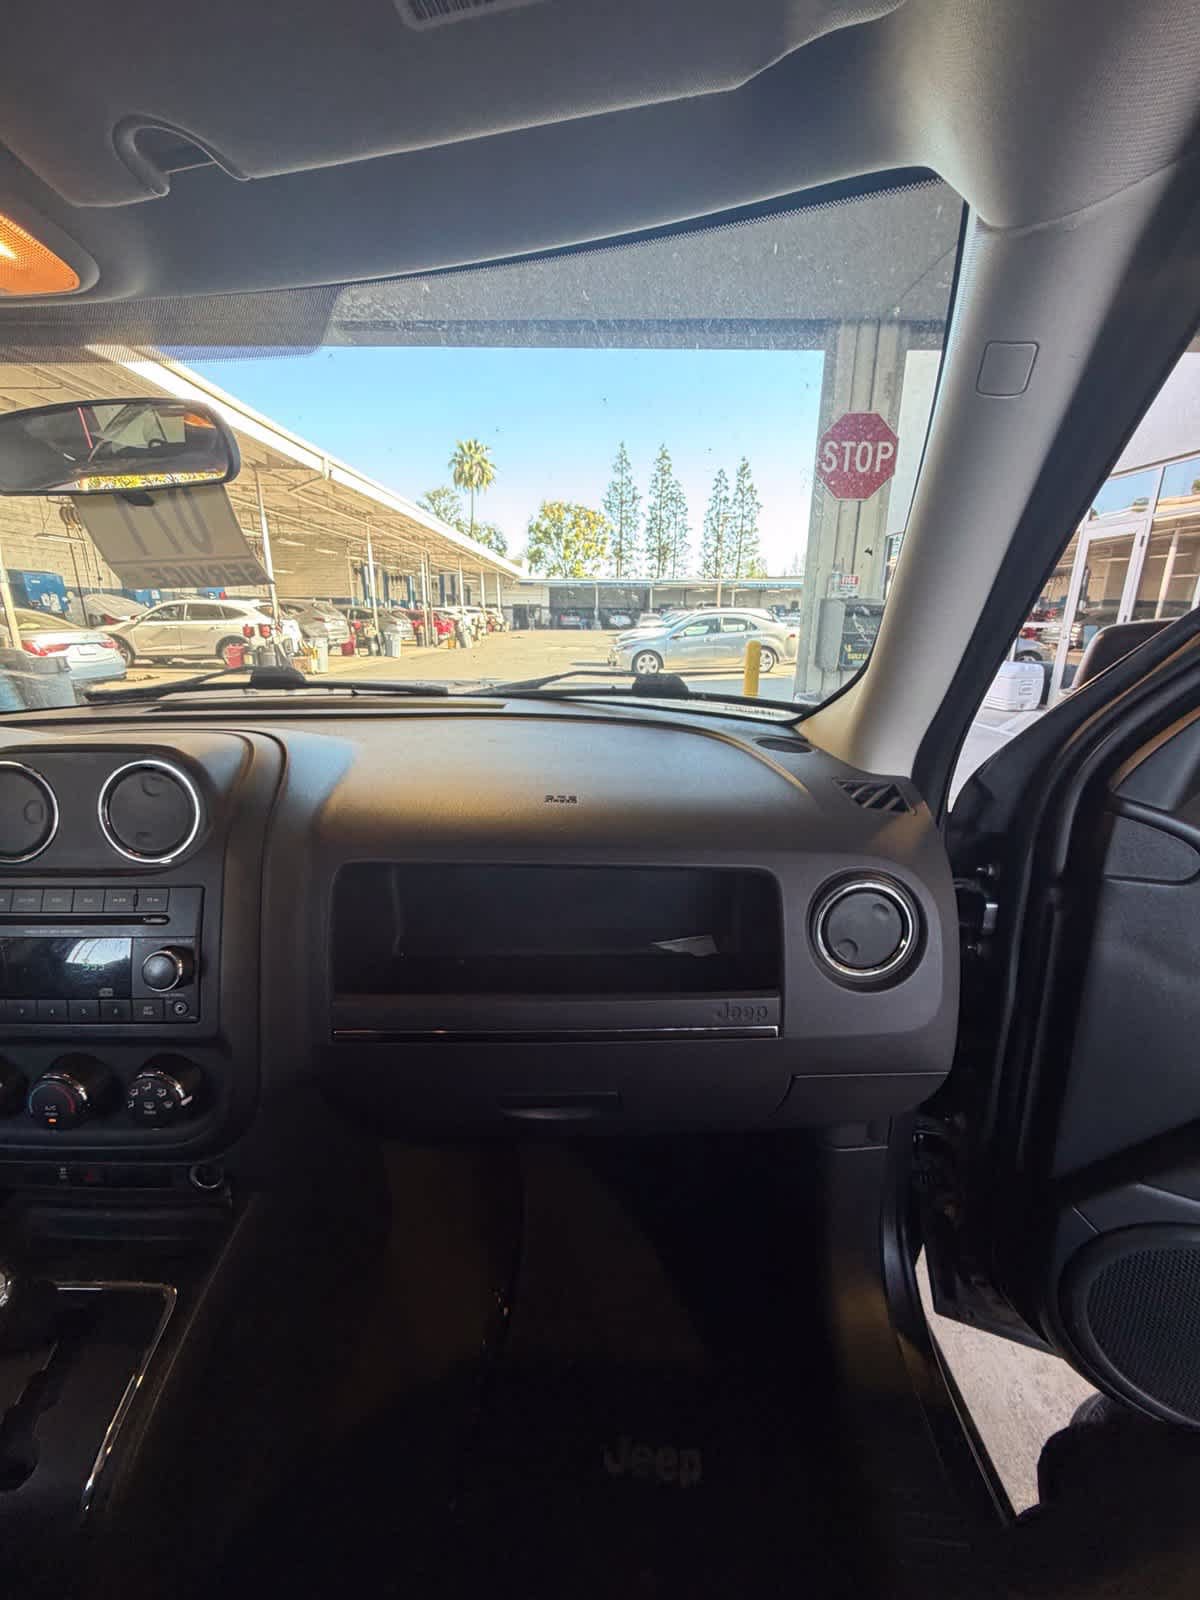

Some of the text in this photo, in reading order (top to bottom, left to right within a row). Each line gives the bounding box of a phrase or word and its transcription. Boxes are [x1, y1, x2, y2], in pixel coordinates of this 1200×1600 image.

[821, 440, 894, 473] STOP
[714, 1001, 769, 1022] Jeep
[603, 1435, 703, 1488] Jeep
